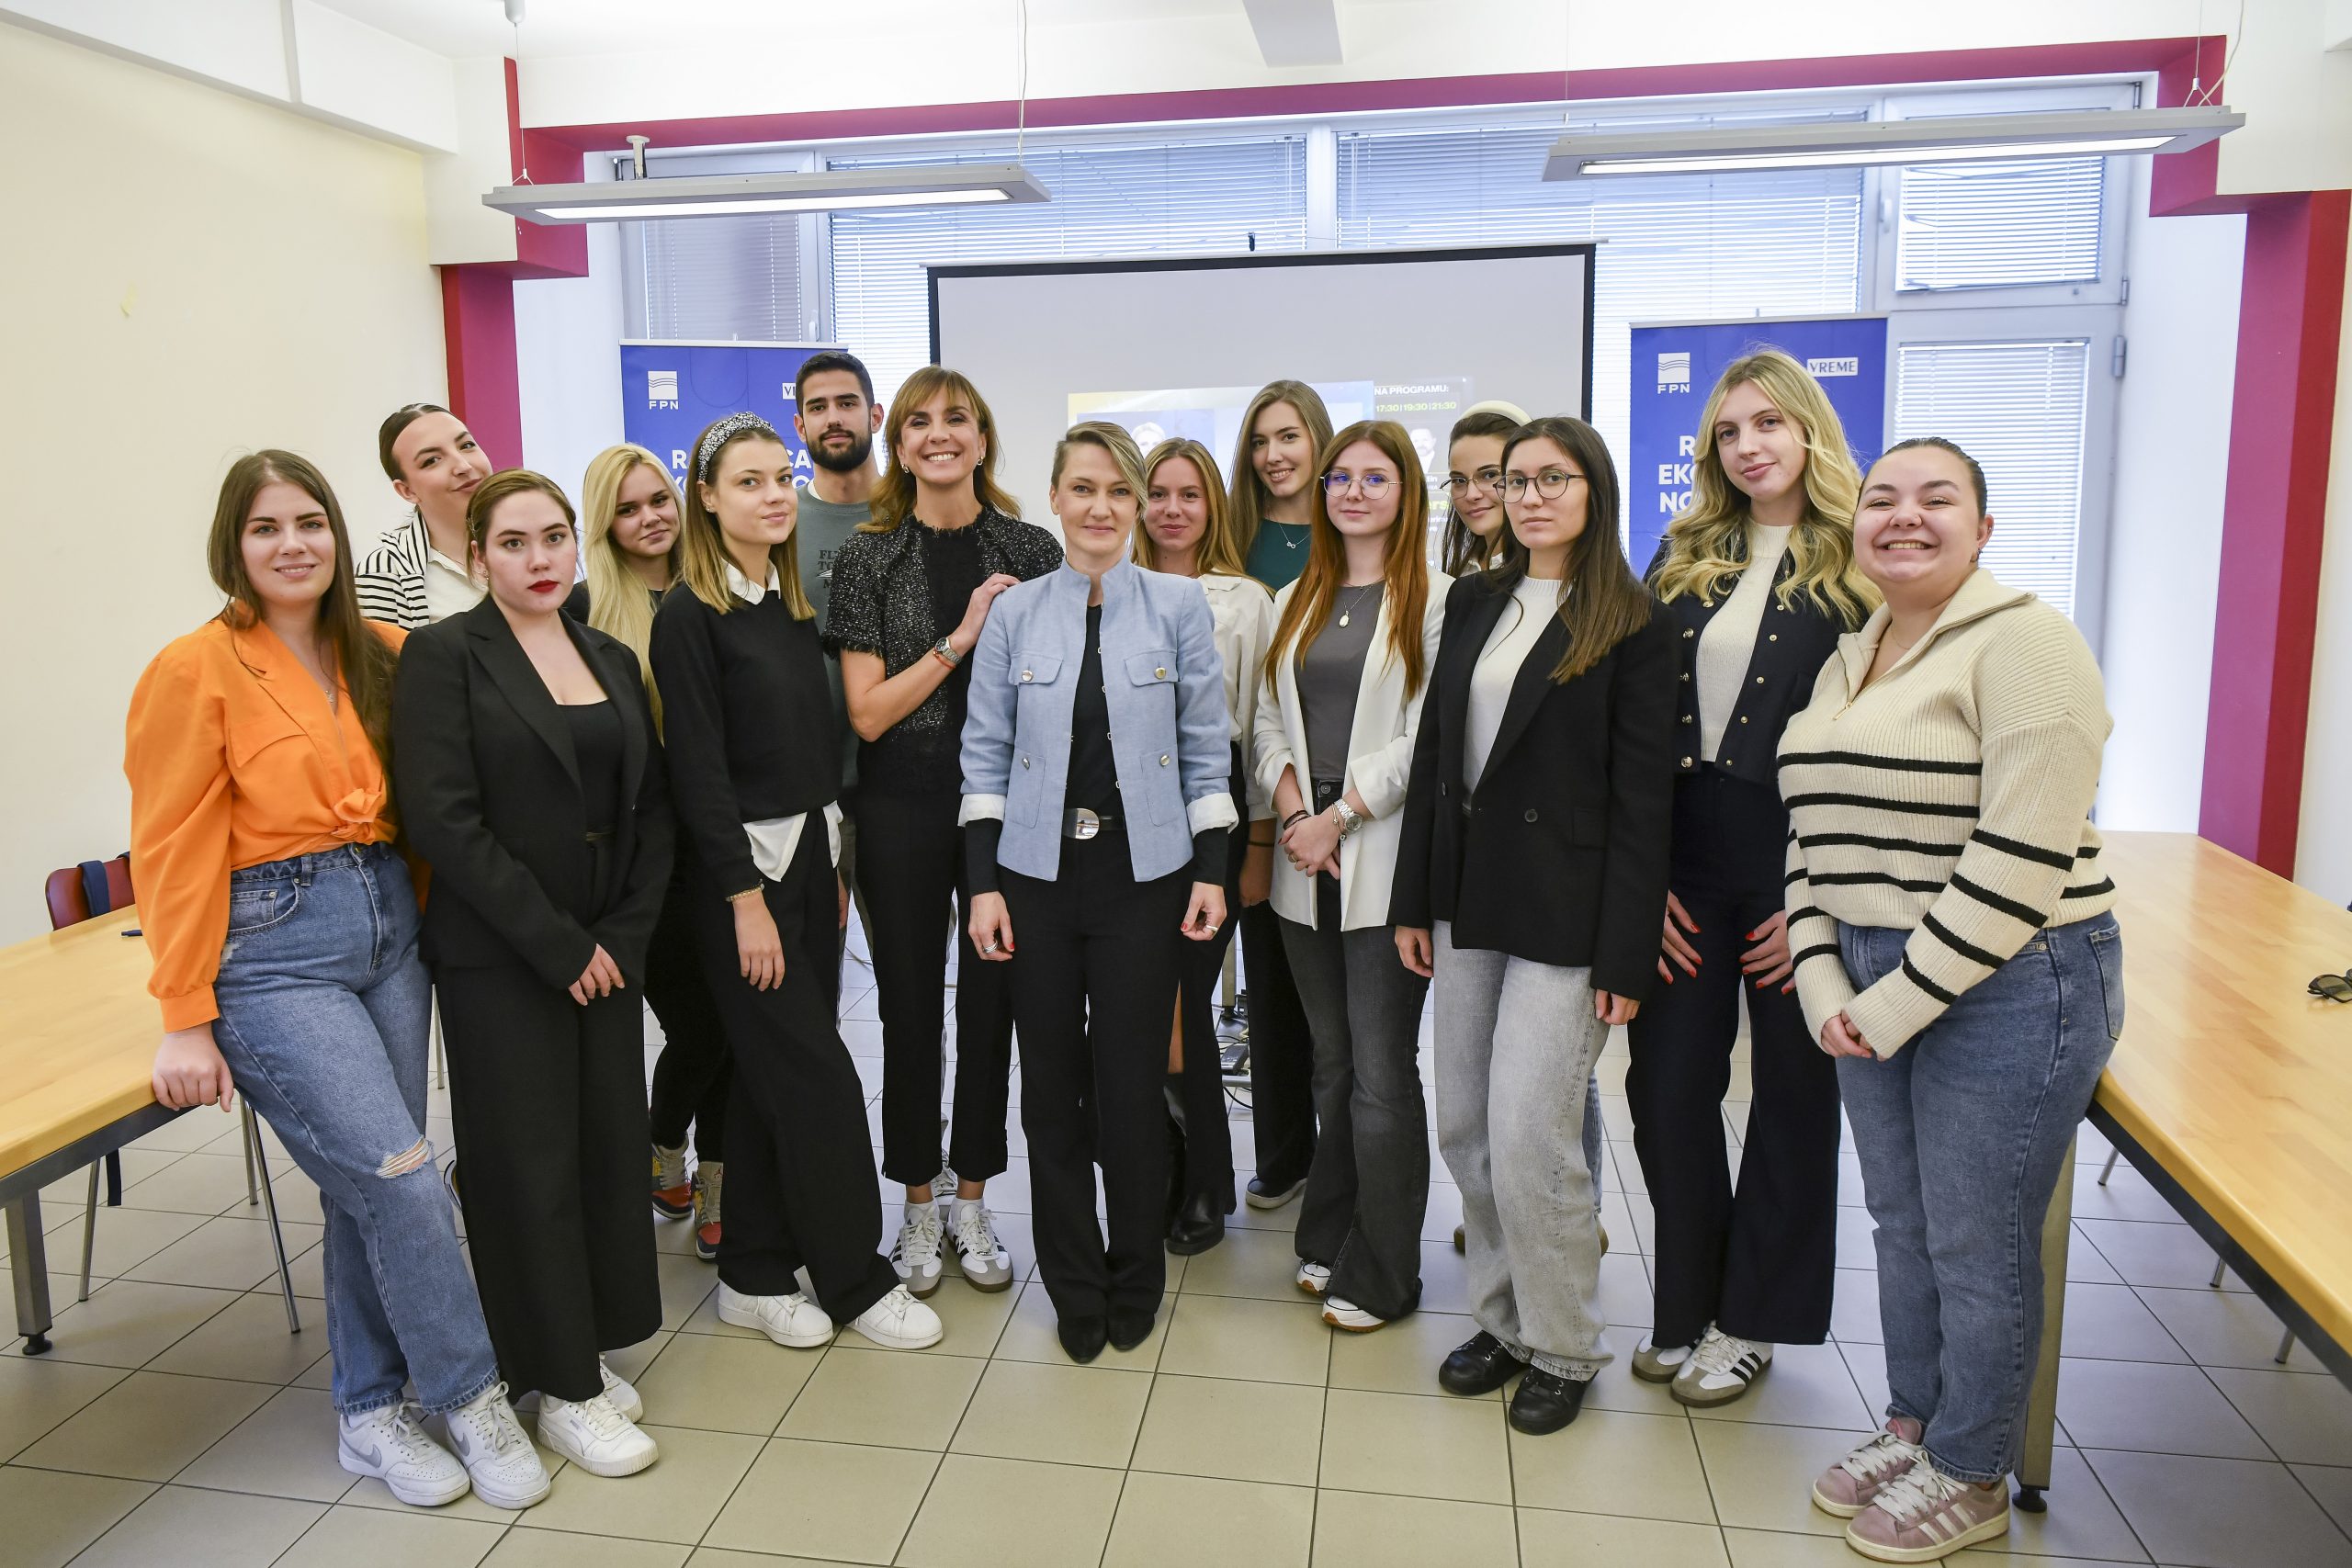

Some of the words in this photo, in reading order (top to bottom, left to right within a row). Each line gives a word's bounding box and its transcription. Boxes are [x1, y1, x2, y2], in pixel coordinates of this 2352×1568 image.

[1809, 361, 1856, 373] VREME
[784, 386, 797, 396] V
[1374, 387, 1388, 395] NA
[1389, 384, 1449, 395] PROGRAMU:
[1657, 383, 1690, 394] FPN
[649, 400, 679, 410] FPN
